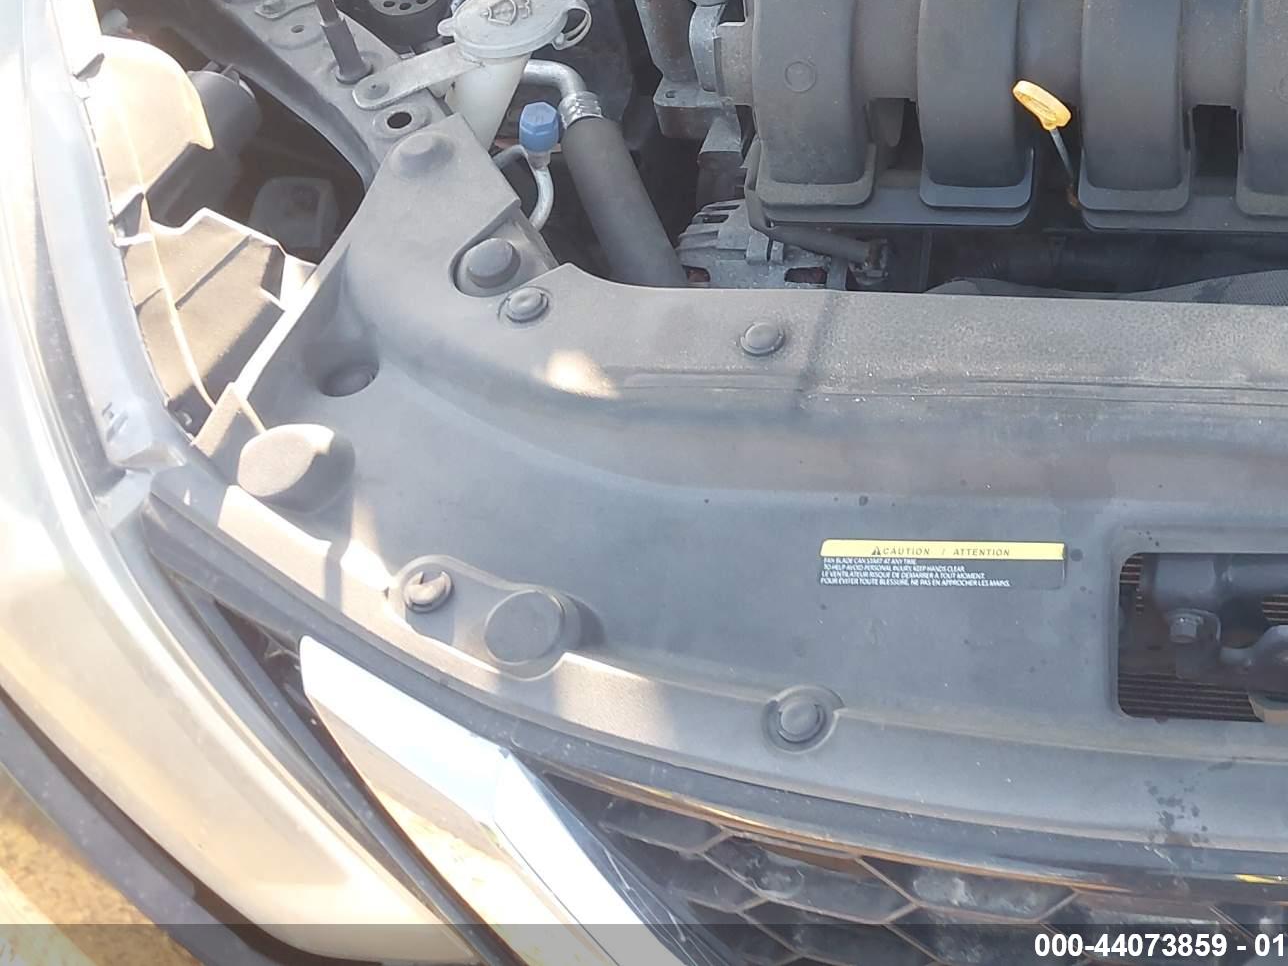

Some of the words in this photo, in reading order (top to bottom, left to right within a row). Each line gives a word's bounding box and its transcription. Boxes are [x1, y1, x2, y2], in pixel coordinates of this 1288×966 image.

[883, 547, 930, 555] CAUTION
[953, 548, 1010, 556] ATTENTION
[910, 578, 919, 586] NE
